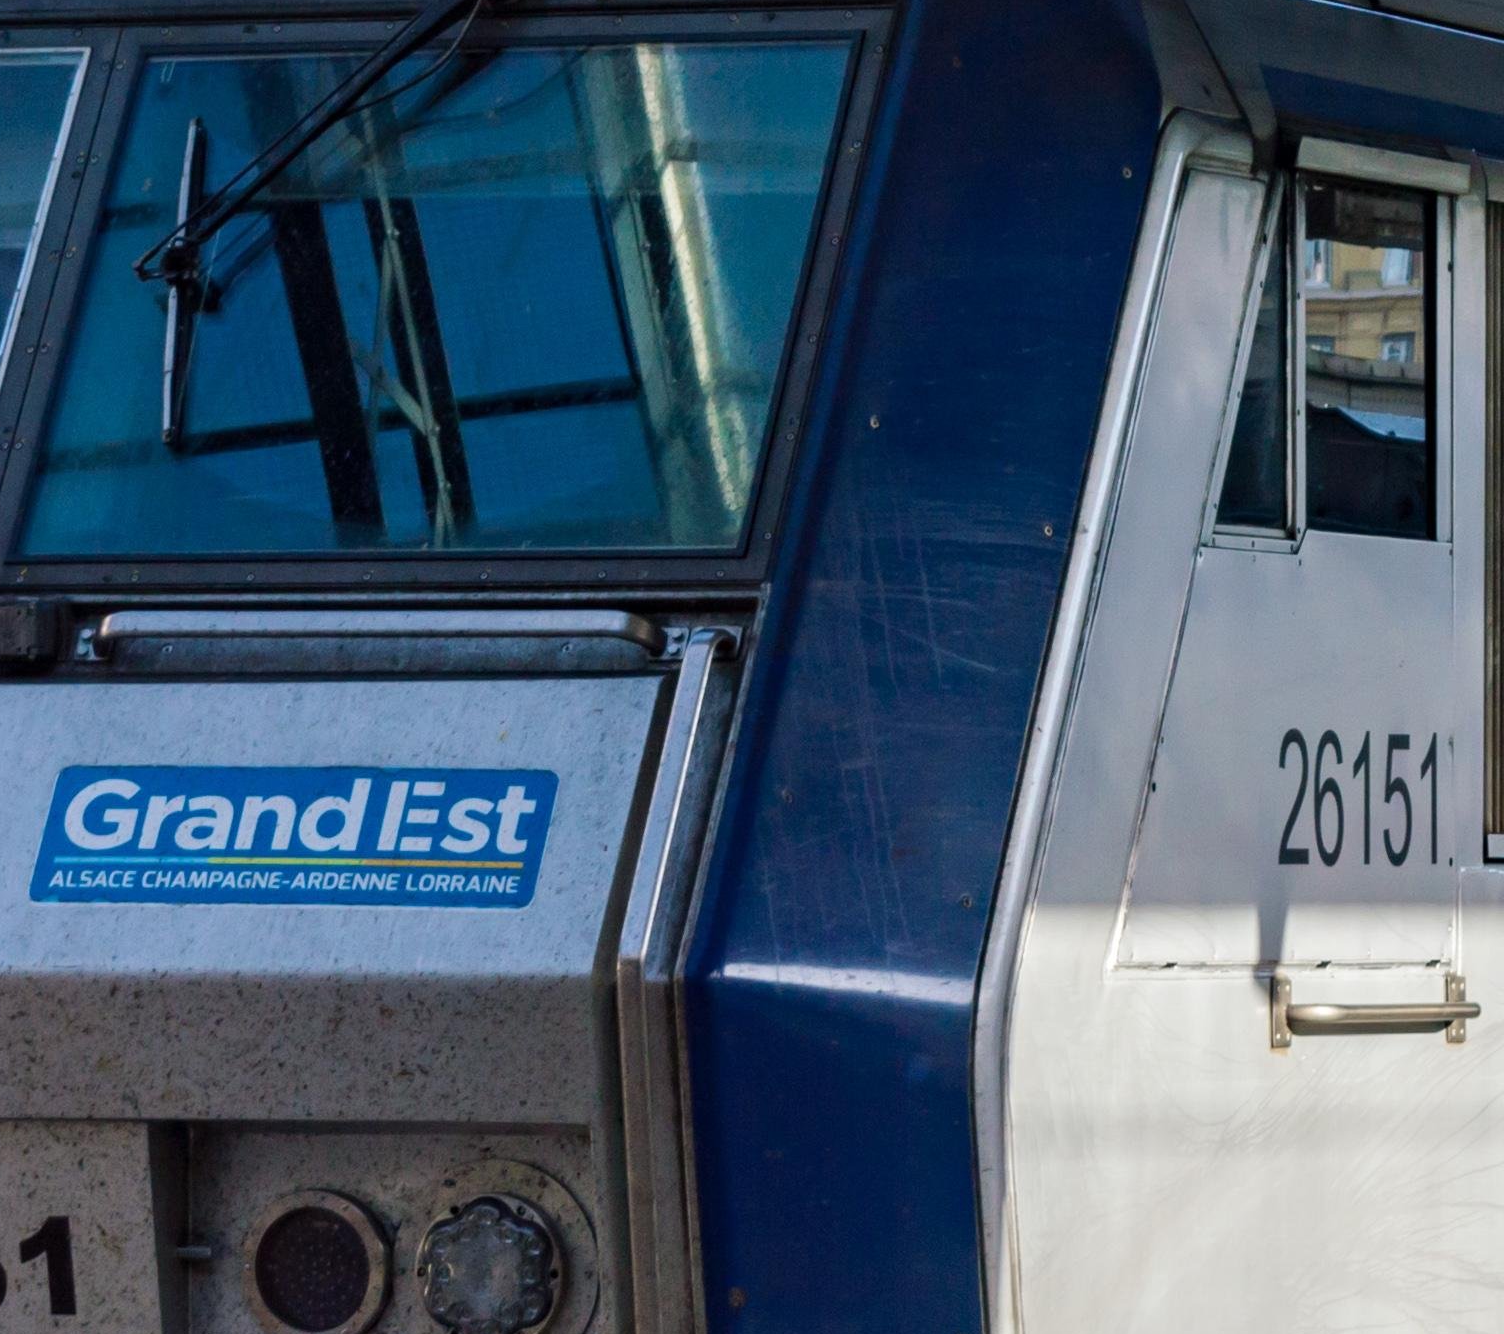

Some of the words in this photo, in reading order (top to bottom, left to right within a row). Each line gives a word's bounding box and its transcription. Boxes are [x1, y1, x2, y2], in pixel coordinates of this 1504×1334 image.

[1278, 727, 1440, 868] 26151
[48, 870, 136, 889] ALSACE
[141, 870, 399, 892] CHAMPAGNE-ARDENNE
[403, 874, 522, 894] LORRAINE
